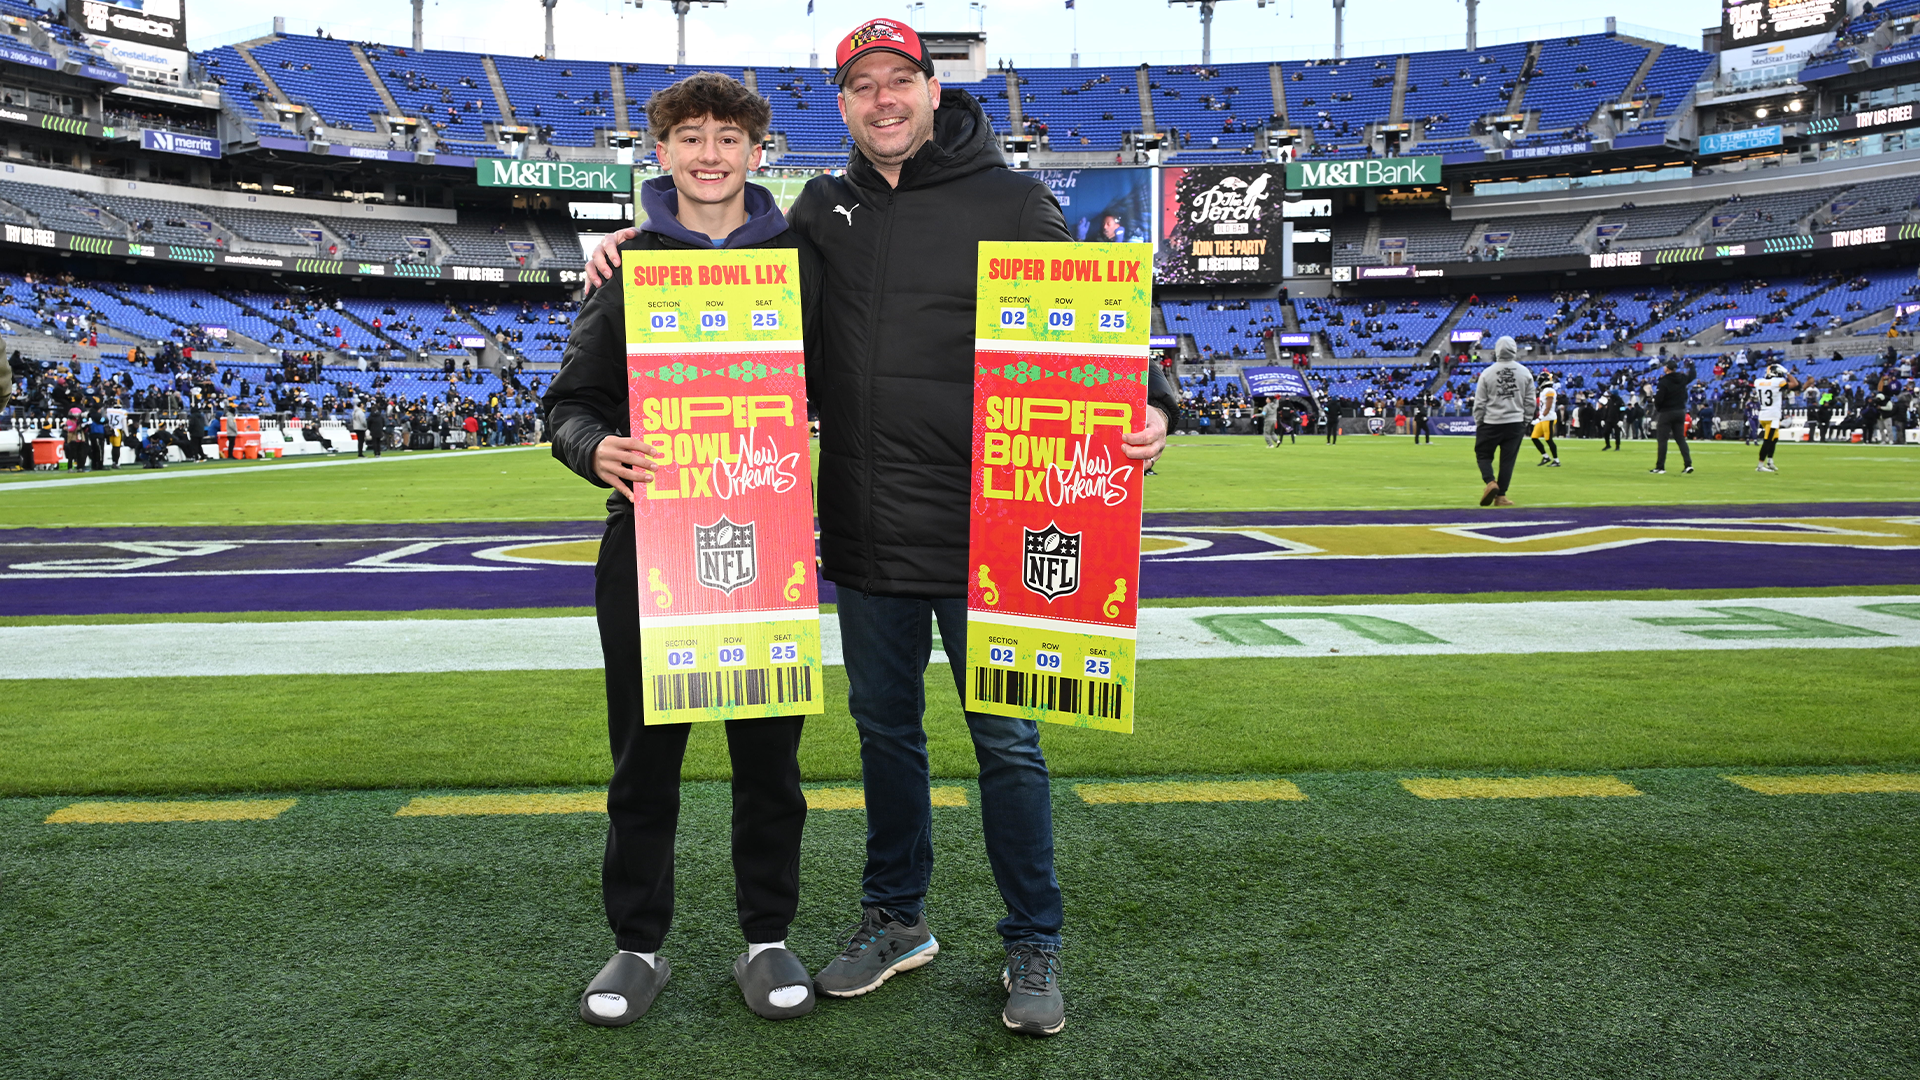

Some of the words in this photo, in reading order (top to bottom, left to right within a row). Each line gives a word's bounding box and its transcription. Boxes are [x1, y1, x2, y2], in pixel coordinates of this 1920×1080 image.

[10, 51, 48, 67] 2006-2014
[112, 47, 168, 64] Constellation
[1752, 54, 1783, 66] MedStar
[1880, 52, 1916, 65] MARSHAL
[1855, 111, 1874, 128] TRY
[1874, 108, 1888, 126] US
[1887, 104, 1912, 123] FREE!
[174, 137, 212, 151] merritt
[1720, 128, 1776, 142] STRATEGIC
[1720, 136, 1776, 151] FACTORY
[491, 160, 557, 188] M&T
[559, 163, 617, 190] Bank
[1301, 161, 1364, 187] M&T
[1366, 159, 1426, 184] Bank
[1191, 185, 1269, 223] Perch
[5, 224, 20, 242] TRY
[21, 227, 34, 246] US
[34, 229, 56, 248] FREE!
[1216, 225, 1231, 233] OLD
[1232, 225, 1246, 233] BAY
[1831, 231, 1850, 247] TRY
[1849, 229, 1862, 246] US
[1862, 226, 1886, 243] FREE!
[1191, 240, 1213, 256] JOIN
[1214, 240, 1233, 255] THE
[1234, 240, 1266, 255] PARTY
[1603, 253, 1617, 267] US
[1617, 251, 1641, 266] FREE!
[452, 266, 470, 281] TRY
[469, 267, 481, 281] US
[481, 268, 504, 282] FREE!
[634, 265, 693, 286] SUPER
[698, 264, 751, 286] BOWL
[755, 264, 788, 284] LIX
[989, 258, 1045, 280] SUPER
[1050, 259, 1102, 282] BOWL
[1107, 260, 1141, 283] LIX
[647, 301, 681, 309] SECTION
[999, 296, 1031, 304] SECTION
[651, 314, 677, 329] 02
[701, 313, 726, 327] 09
[753, 313, 778, 327] 25
[1001, 311, 1025, 326] 02
[1048, 312, 1074, 327] 09
[1100, 313, 1125, 329] 25
[1759, 389, 1773, 407] 13
[110, 414, 121, 426] 15
[643, 394, 795, 431] SUPER
[986, 395, 1133, 435] SUPER
[643, 432, 741, 467] BOWL
[733, 426, 779, 472] New
[983, 432, 1074, 471] BOWL
[1069, 433, 1112, 477] New
[645, 467, 713, 500] LIX
[713, 453, 800, 501] Orleans
[983, 468, 1046, 503] LIX
[1046, 465, 1134, 507] Orleans
[702, 549, 751, 585] NFL
[1029, 556, 1074, 592] NFL
[665, 639, 698, 648] SECTION
[723, 637, 743, 645] ROW
[773, 634, 792, 642] SEAT
[988, 636, 1018, 645] SECTION
[1041, 642, 1060, 651] ROW
[1089, 648, 1107, 656] SEAT
[668, 651, 694, 666] 02
[719, 648, 745, 662] 09
[771, 645, 796, 660] 25
[990, 648, 1014, 663] 02
[1037, 653, 1060, 668] 09
[1085, 659, 1110, 675] 25
